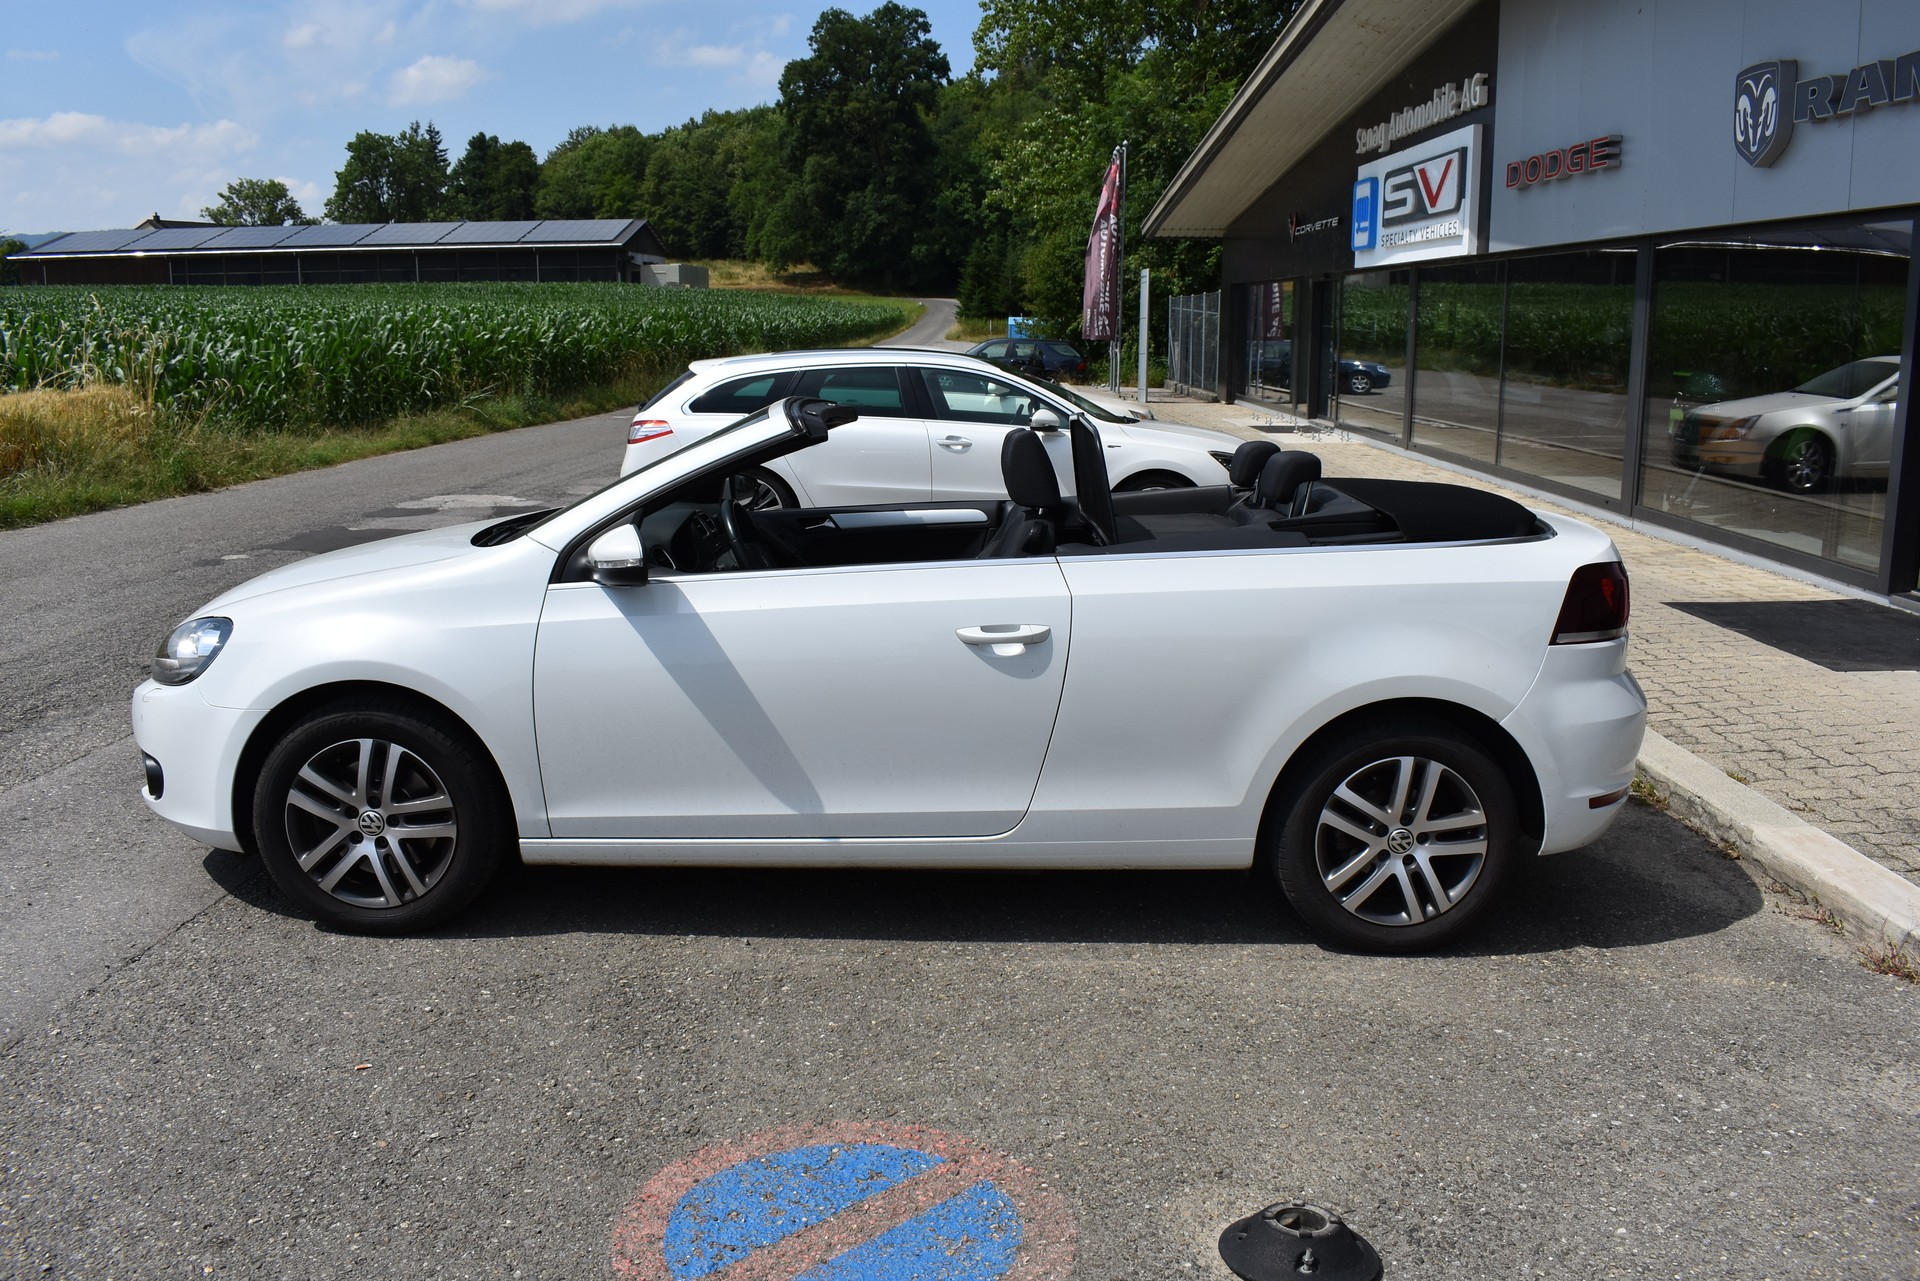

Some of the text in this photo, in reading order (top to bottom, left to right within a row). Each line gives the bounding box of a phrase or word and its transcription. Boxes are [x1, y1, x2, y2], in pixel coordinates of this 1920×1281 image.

[1356, 73, 1488, 154] Senag Automobile AG
[1383, 158, 1454, 220] SV
[1506, 135, 1612, 189] DODGE
[1294, 216, 1340, 236] CORVETTE
[1381, 221, 1458, 247] SPECIALTY VEHICLES
